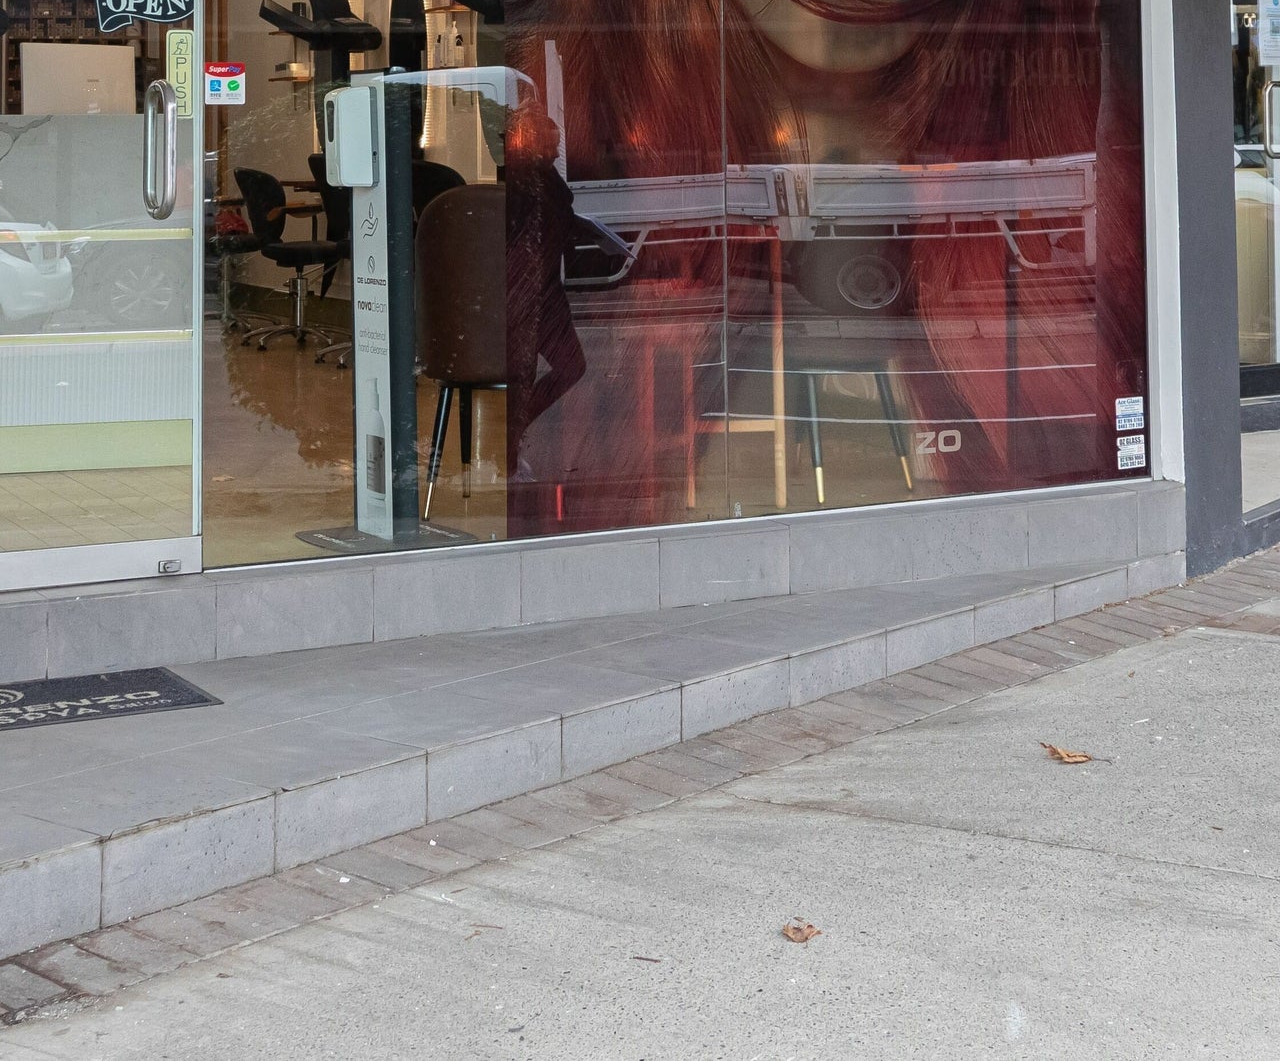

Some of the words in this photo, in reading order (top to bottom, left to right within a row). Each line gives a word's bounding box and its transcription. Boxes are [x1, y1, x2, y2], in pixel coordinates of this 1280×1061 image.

[176, 57, 186, 113] PUSH
[365, 278, 386, 286] LORENZO
[915, 429, 962, 455] ZO
